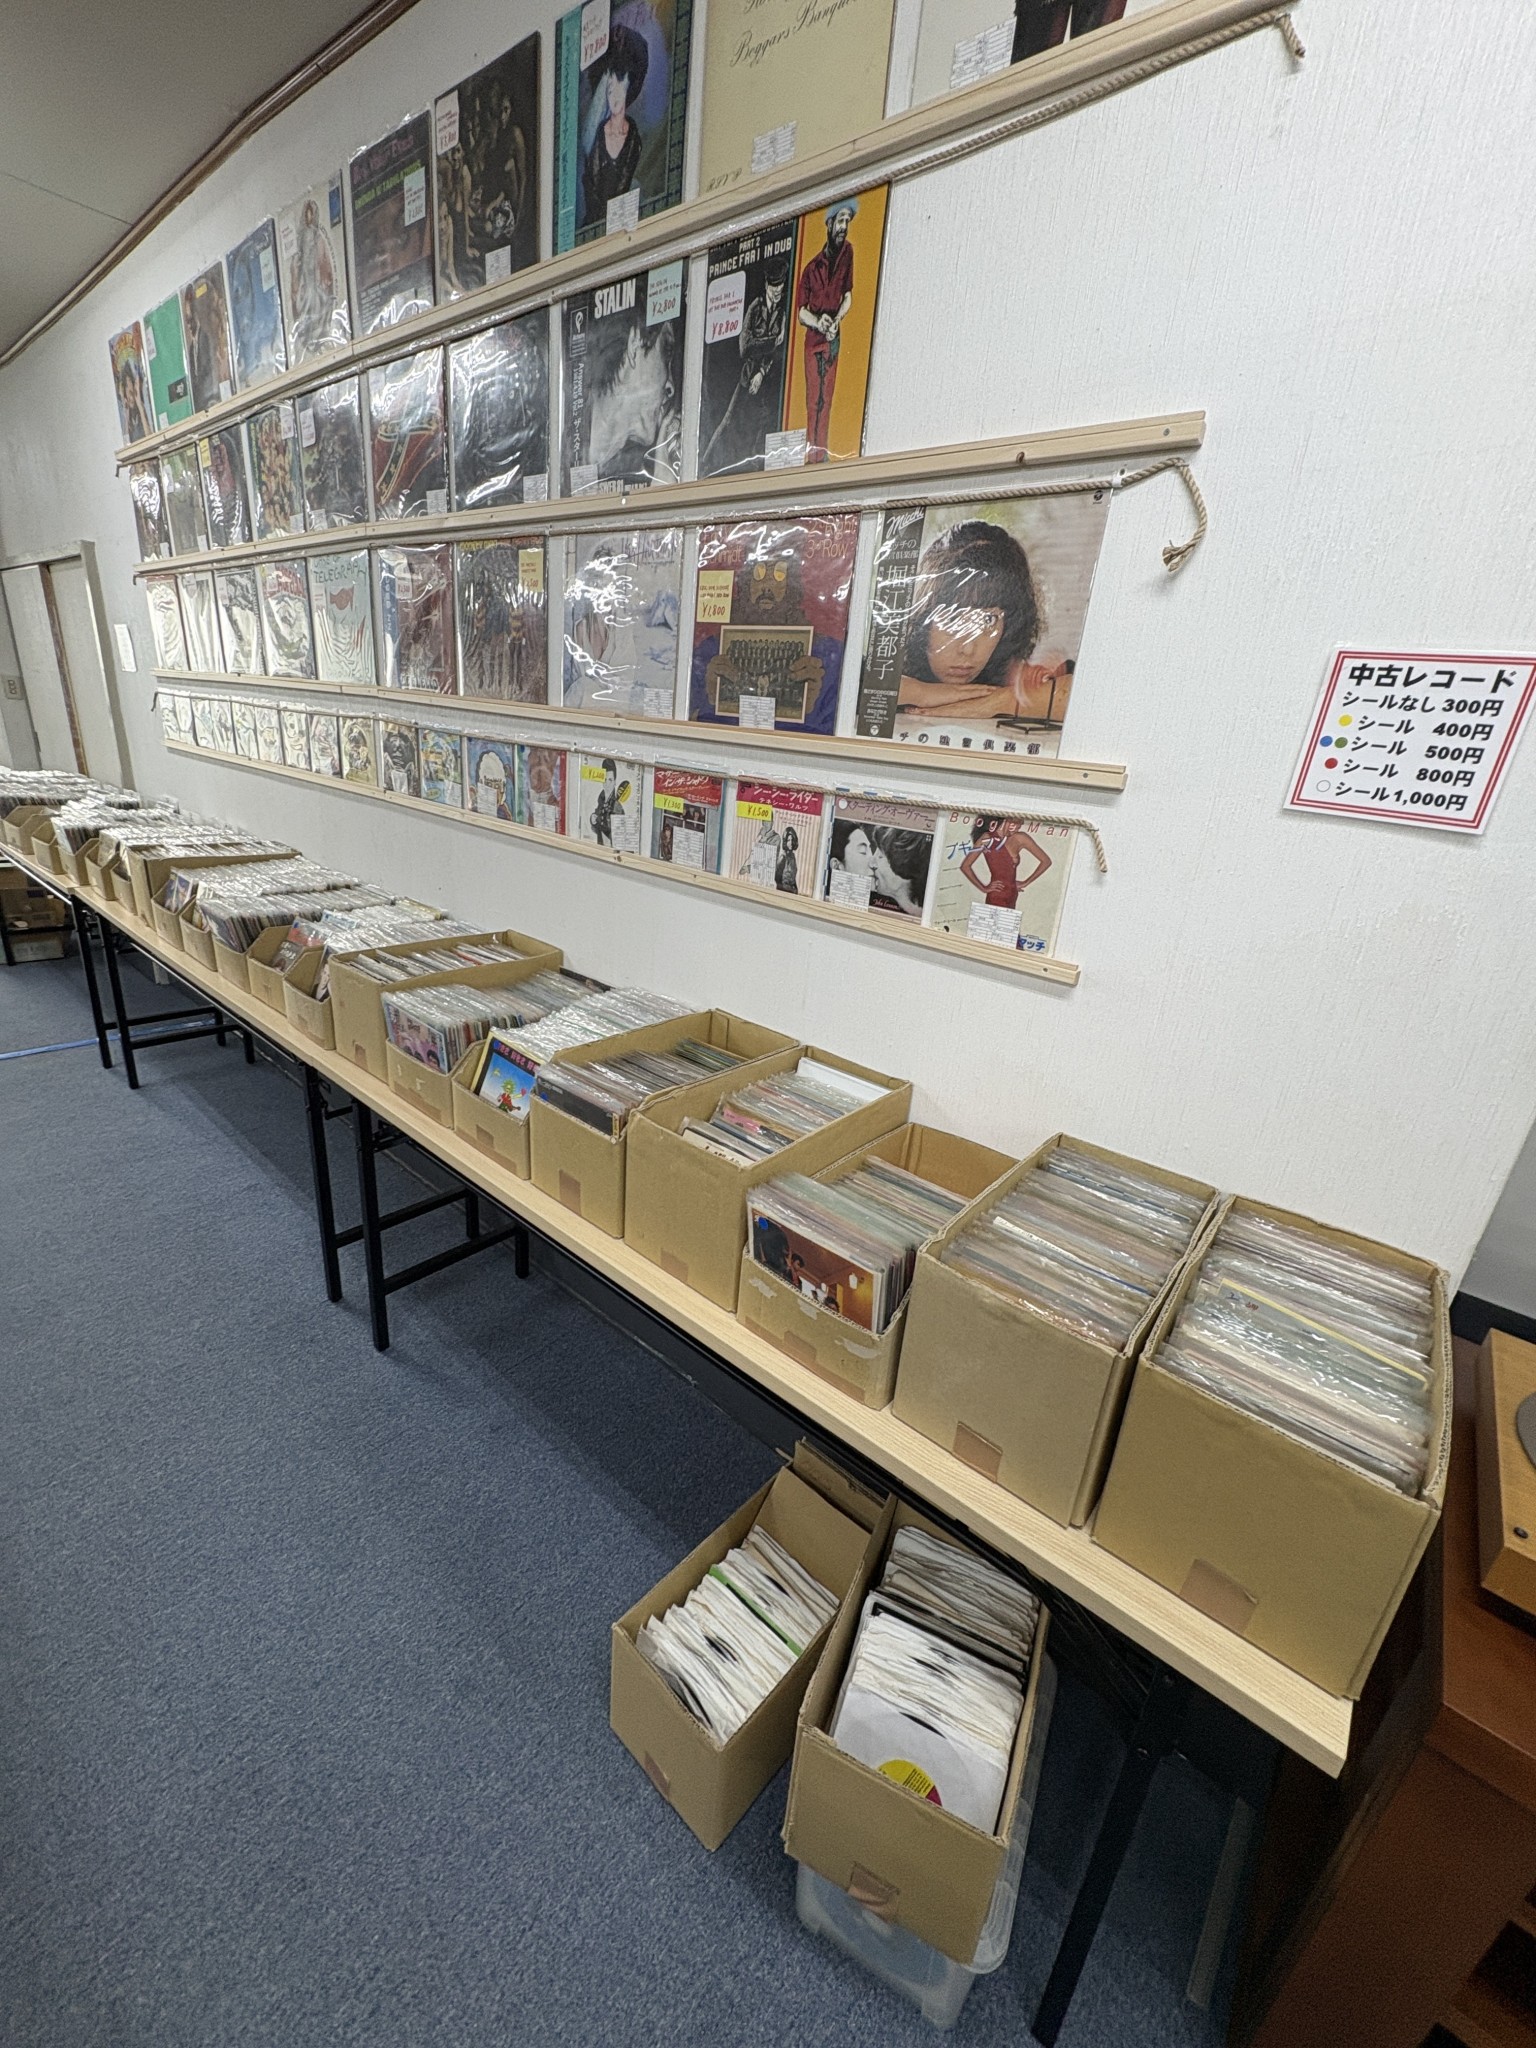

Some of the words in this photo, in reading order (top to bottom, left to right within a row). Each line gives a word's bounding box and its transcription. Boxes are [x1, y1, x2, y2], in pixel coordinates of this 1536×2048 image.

[729, 27, 790, 68] Beggars
[709, 256, 738, 278] PRINCE
[764, 243, 774, 258] IN
[774, 236, 793, 254] DUB
[739, 239, 755, 253] PART
[756, 236, 760, 247] 2
[594, 278, 636, 319] STALIN
[711, 320, 739, 340] ¥8,800
[702, 602, 726, 618] ¥1,800
[1349, 663, 1517, 693] 中古レコード
[1342, 691, 1436, 713] シールなし
[1442, 699, 1504, 717] 300円
[1358, 715, 1415, 735] シール
[1433, 723, 1494, 741] 400円
[1351, 736, 1407, 756] シール
[1424, 745, 1485, 764] 500円
[1343, 759, 1398, 779] シール
[1416, 768, 1475, 787] 800円
[759, 797, 808, 811] テネシー・ワルツ
[1335, 782, 1389, 801] シール
[1393, 789, 1468, 811] 1,000円
[949, 811, 1018, 832] Boogie
[1027, 821, 1069, 838] Man
